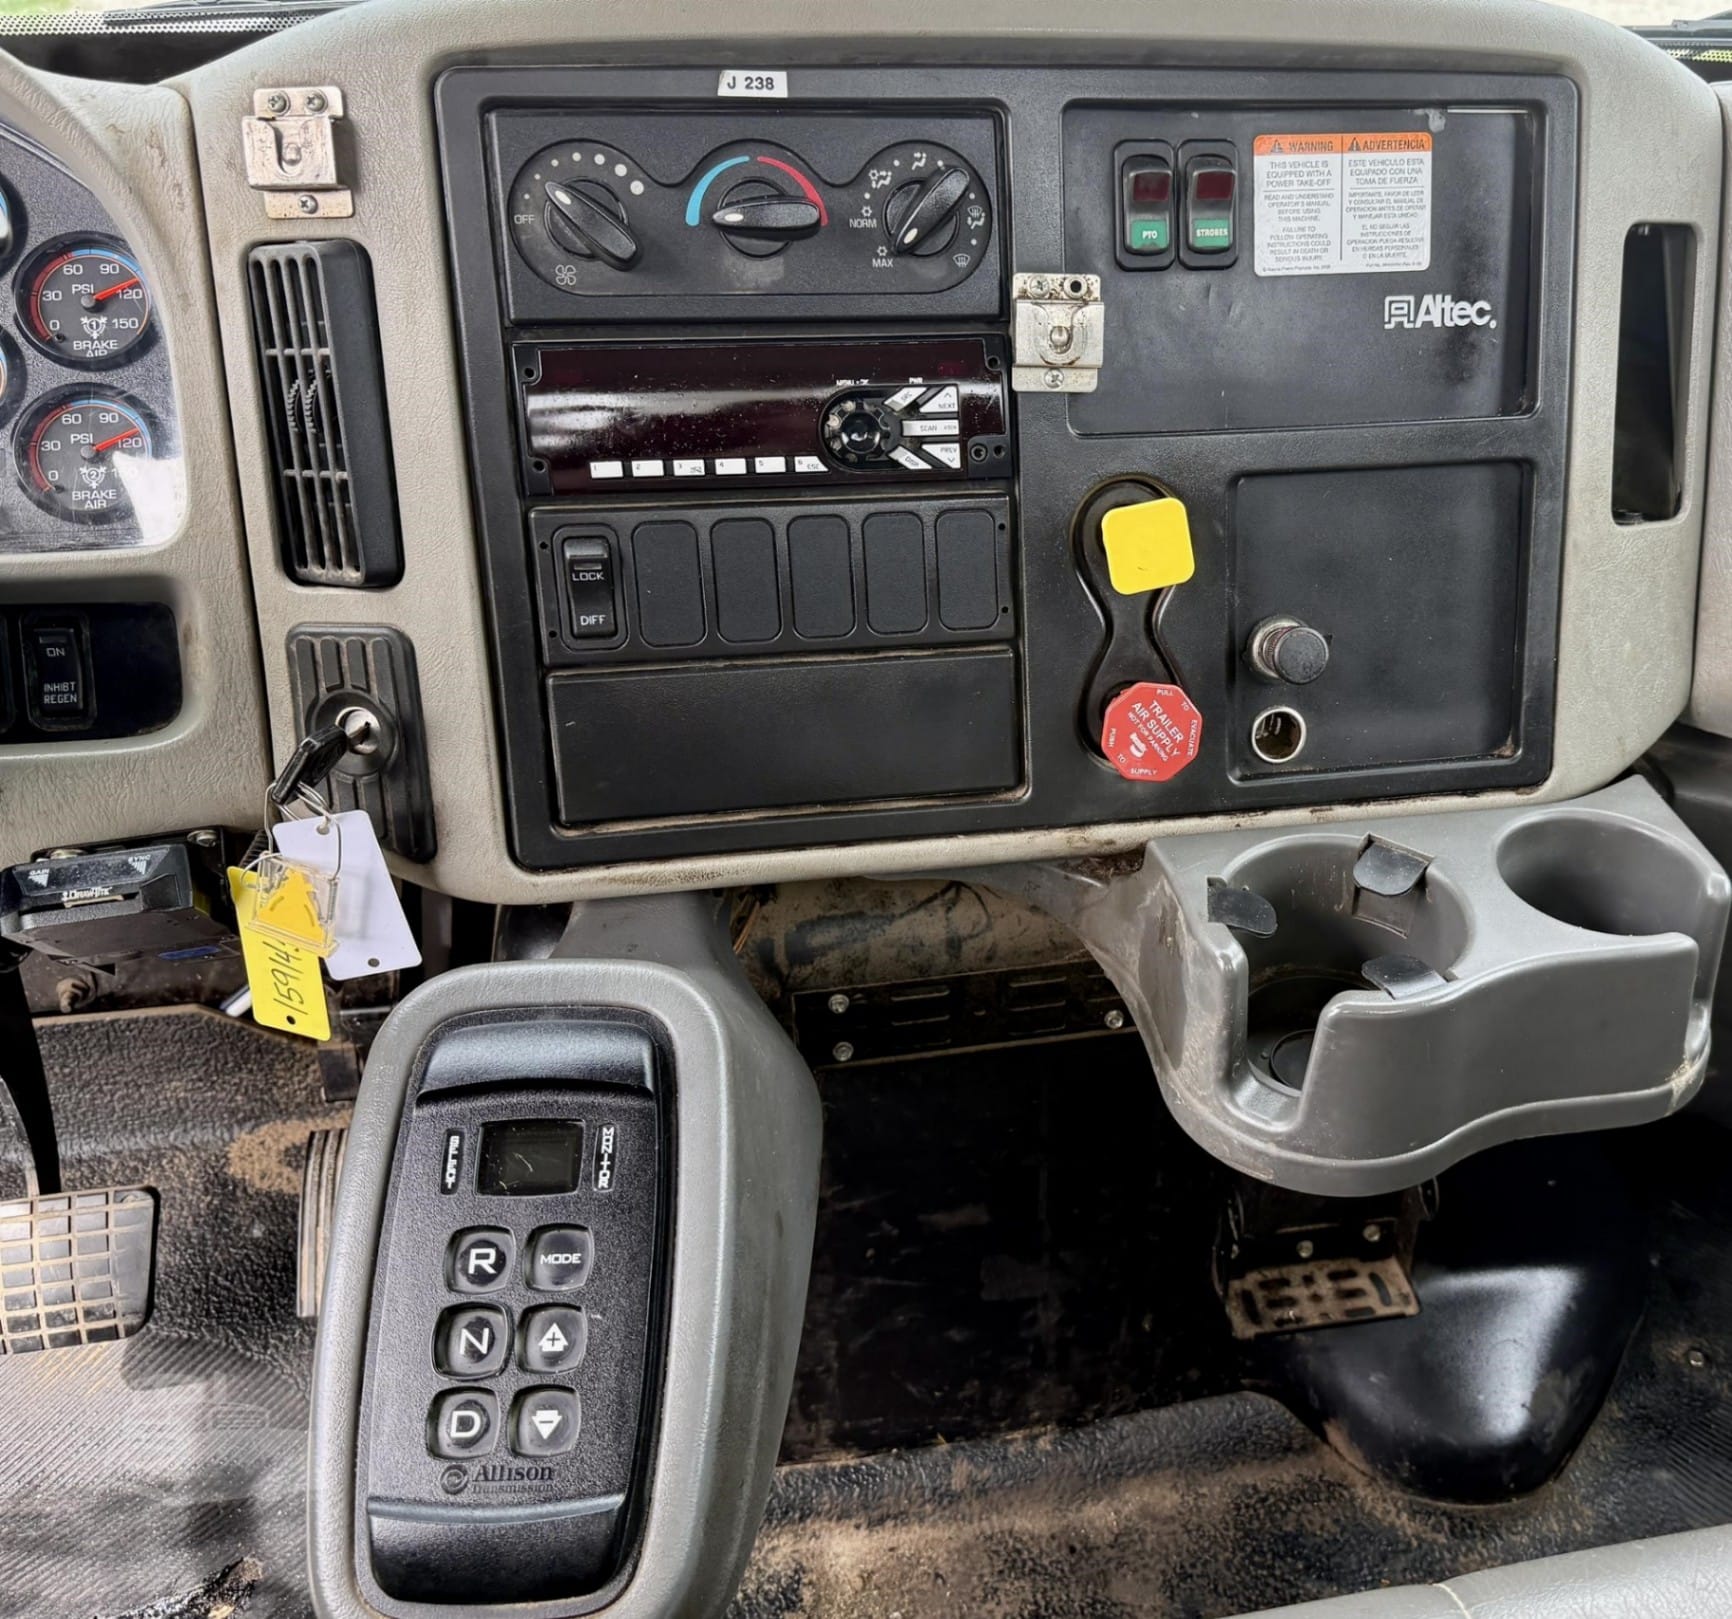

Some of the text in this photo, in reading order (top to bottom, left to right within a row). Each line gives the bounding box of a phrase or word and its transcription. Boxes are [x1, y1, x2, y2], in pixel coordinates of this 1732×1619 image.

[727, 75, 774, 90] J 238
[1289, 141, 1333, 152] WARNING
[1363, 139, 1425, 150] ADVERTENCIA
[1270, 160, 1328, 169] THIS VEHICLE IS
[1348, 159, 1367, 167] ESTE
[1407, 158, 1424, 166] ESTA
[1266, 169, 1332, 179] EQUIPPED WITH A
[1350, 168, 1387, 176] EQUIPADO
[1407, 167, 1422, 175] UNA
[1266, 179, 1330, 188] POWER TAKE-OFF
[1356, 177, 1376, 185] TOMA
[1389, 176, 1417, 184] FUERZA
[514, 214, 535, 224] OFF
[849, 218, 877, 228] NORM
[1142, 230, 1158, 239] PTO
[1196, 228, 1228, 237] STROBES
[872, 258, 893, 268] MAX
[63, 264, 83, 275] 60
[99, 264, 119, 274] 90
[72, 284, 94, 294] PSI
[117, 289, 143, 299] 120
[42, 290, 62, 301] 30
[50, 320, 60, 330] 0
[112, 318, 139, 329] 150
[73, 340, 119, 350] BRAKE
[62, 413, 82, 424] 60
[99, 413, 119, 423] 90
[920, 424, 937, 432] SCAN
[70, 433, 93, 444] PSI
[117, 437, 142, 448] 120
[41, 440, 61, 451] 30
[48, 470, 59, 480] 0
[111, 467, 138, 479] 10
[72, 489, 117, 500] BRAKE
[84, 500, 107, 509] AIR
[572, 572, 605, 581] LOCK
[580, 615, 606, 625] DIFF
[46, 647, 65, 657] ON
[43, 693, 78, 704] REGEN
[1181, 701, 1190, 711] TO
[1149, 700, 1184, 743] TRAILER
[1132, 702, 1150, 721] AIR
[1147, 719, 1180, 757] SUPPLY
[1128, 712, 1140, 725] NOT
[1138, 723, 1149, 737] FOR
[1148, 735, 1168, 762] PARKING
[1117, 753, 1127, 763] TO
[1131, 767, 1157, 776] SUPPLY
[262, 939, 309, 1015] 15914
[598, 1126, 614, 1189] MONITOR
[468, 1248, 497, 1274] R
[540, 1253, 581, 1265] MODE
[459, 1328, 490, 1354] N
[450, 1410, 481, 1438] D
[472, 1465, 553, 1482] Allison
[472, 1483, 553, 1494] Transmission
